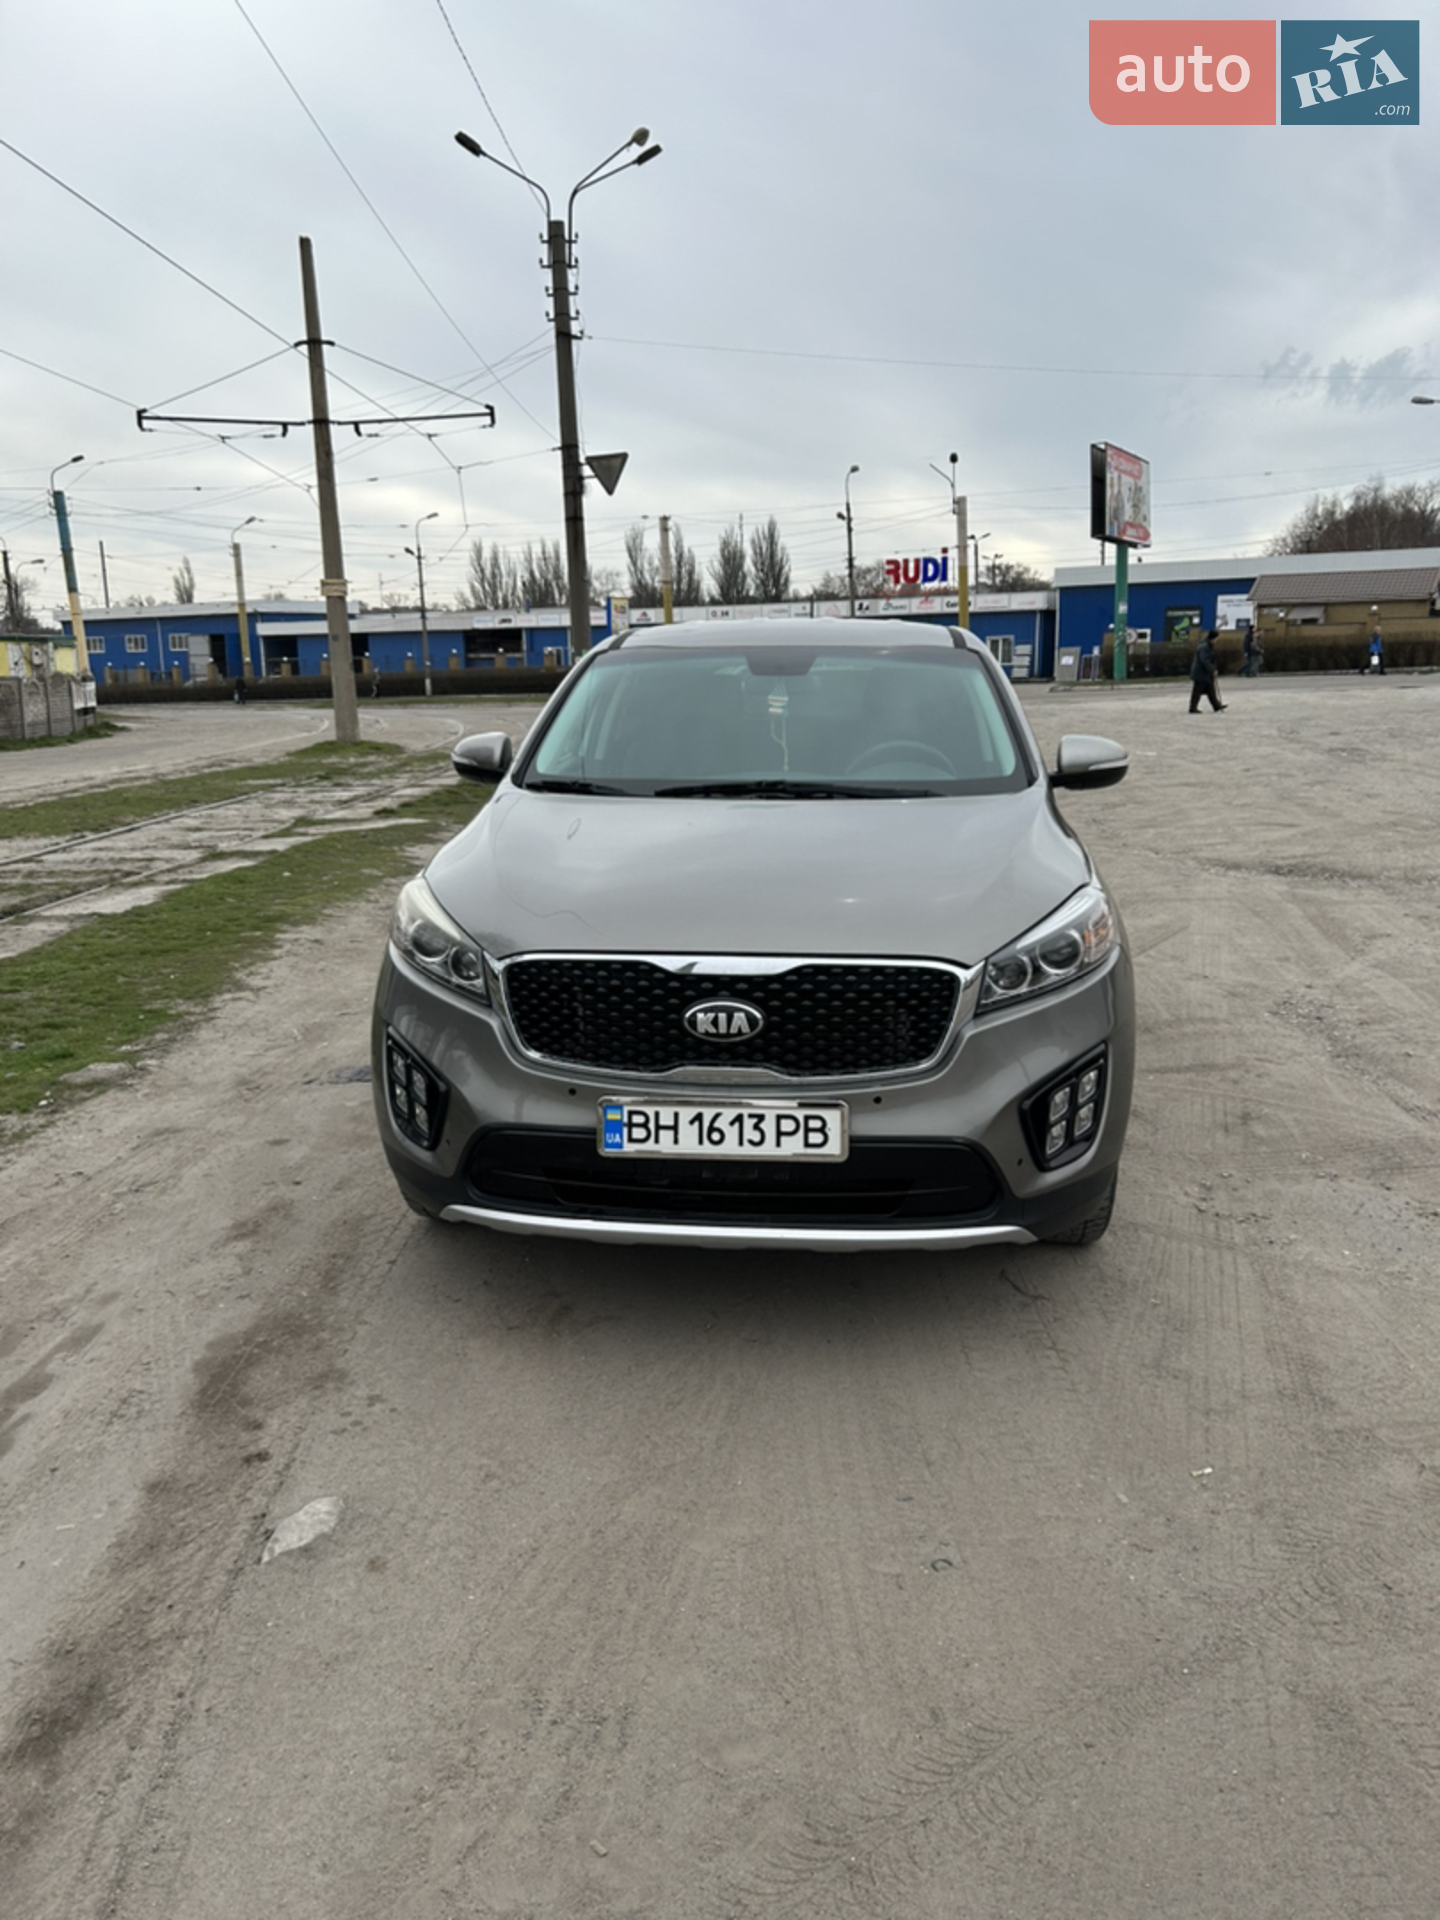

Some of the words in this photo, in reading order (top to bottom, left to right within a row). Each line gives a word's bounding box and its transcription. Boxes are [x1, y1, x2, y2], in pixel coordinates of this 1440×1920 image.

[696, 1012, 751, 1034] KIA
[605, 1133, 621, 1144] UA
[626, 1110, 679, 1145] BH
[688, 1112, 766, 1147] 1613
[775, 1113, 830, 1148] PB
